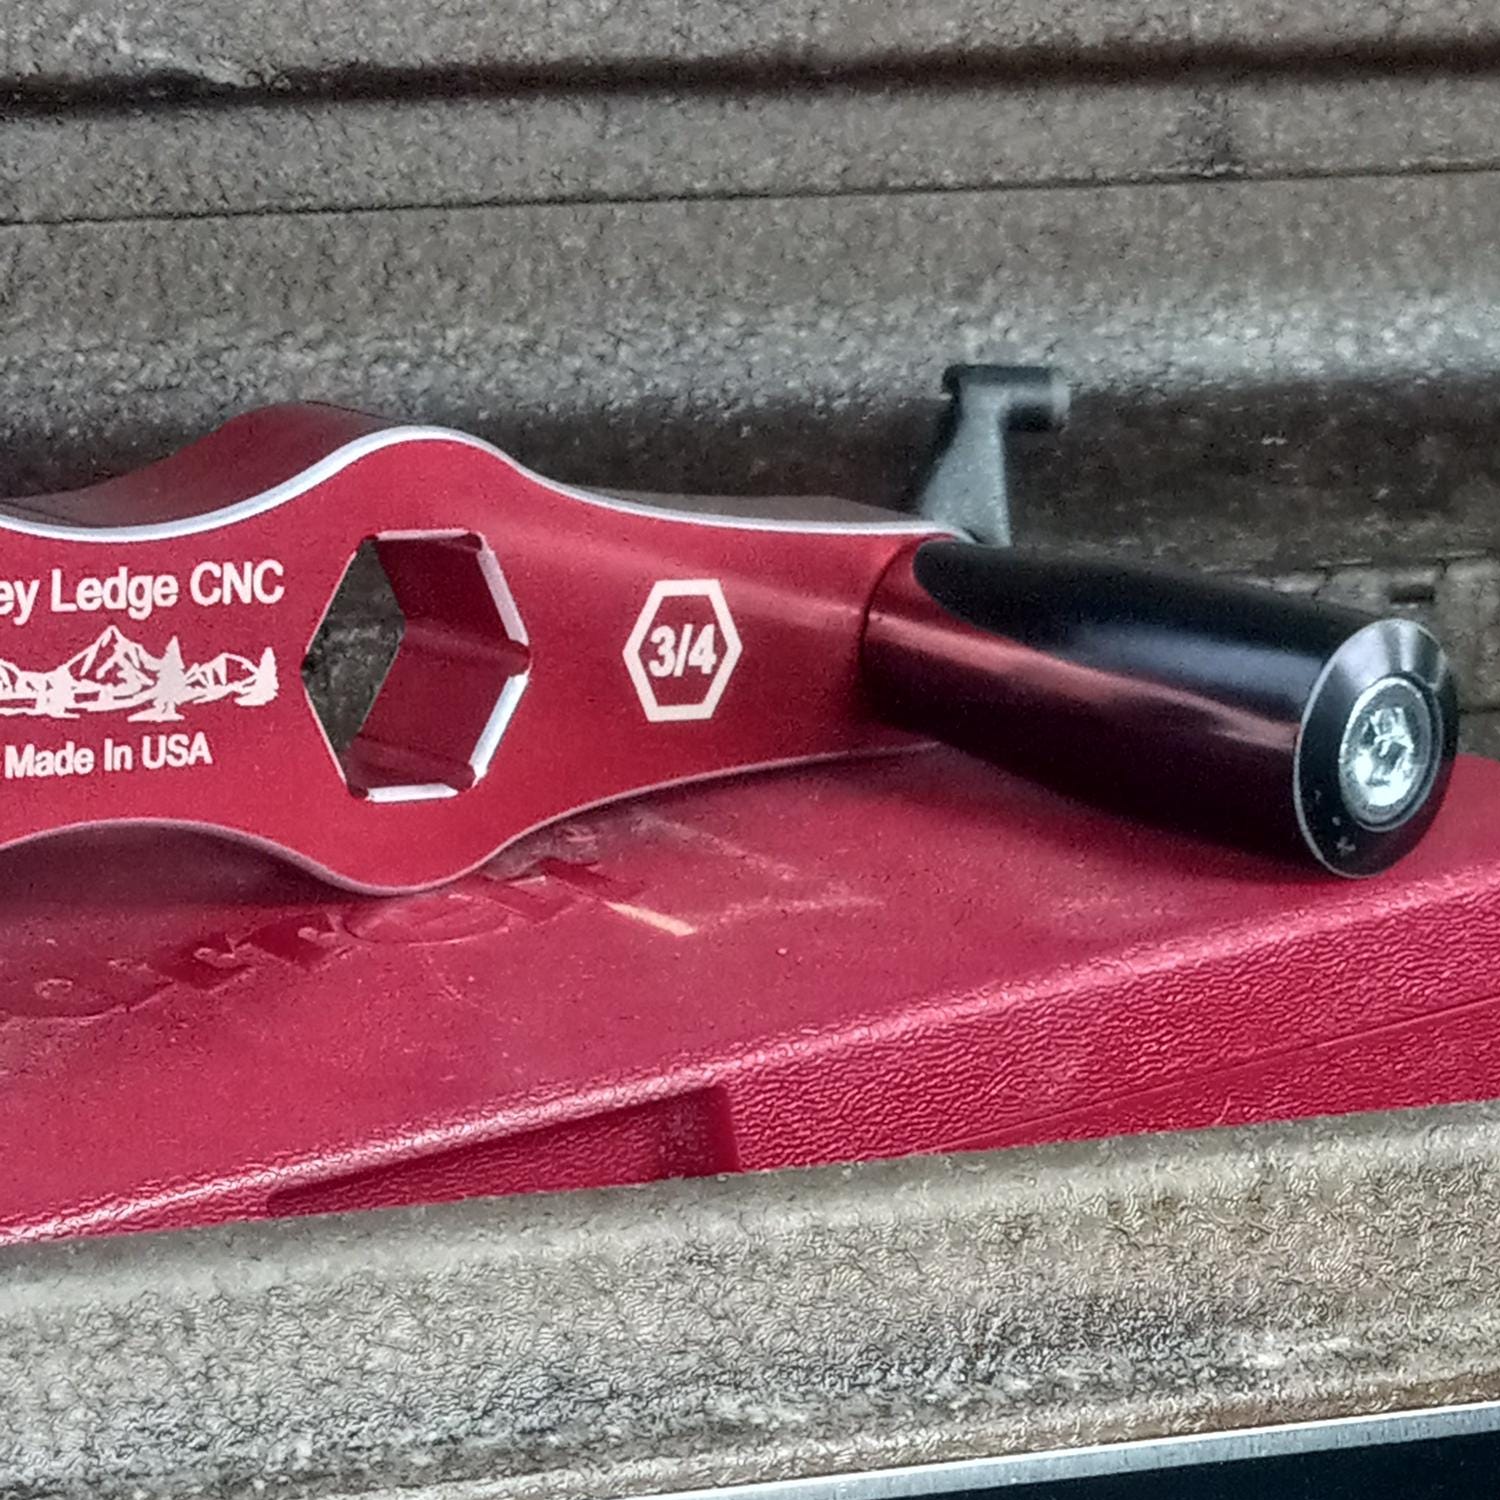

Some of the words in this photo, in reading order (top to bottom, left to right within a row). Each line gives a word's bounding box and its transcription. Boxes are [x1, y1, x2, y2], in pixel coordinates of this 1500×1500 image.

[51, 566, 179, 620] Ledge
[190, 559, 285, 606] CNC
[649, 623, 717, 677] 3/4
[4, 741, 95, 779] Made
[103, 738, 133, 771] In
[142, 732, 213, 770] USA
